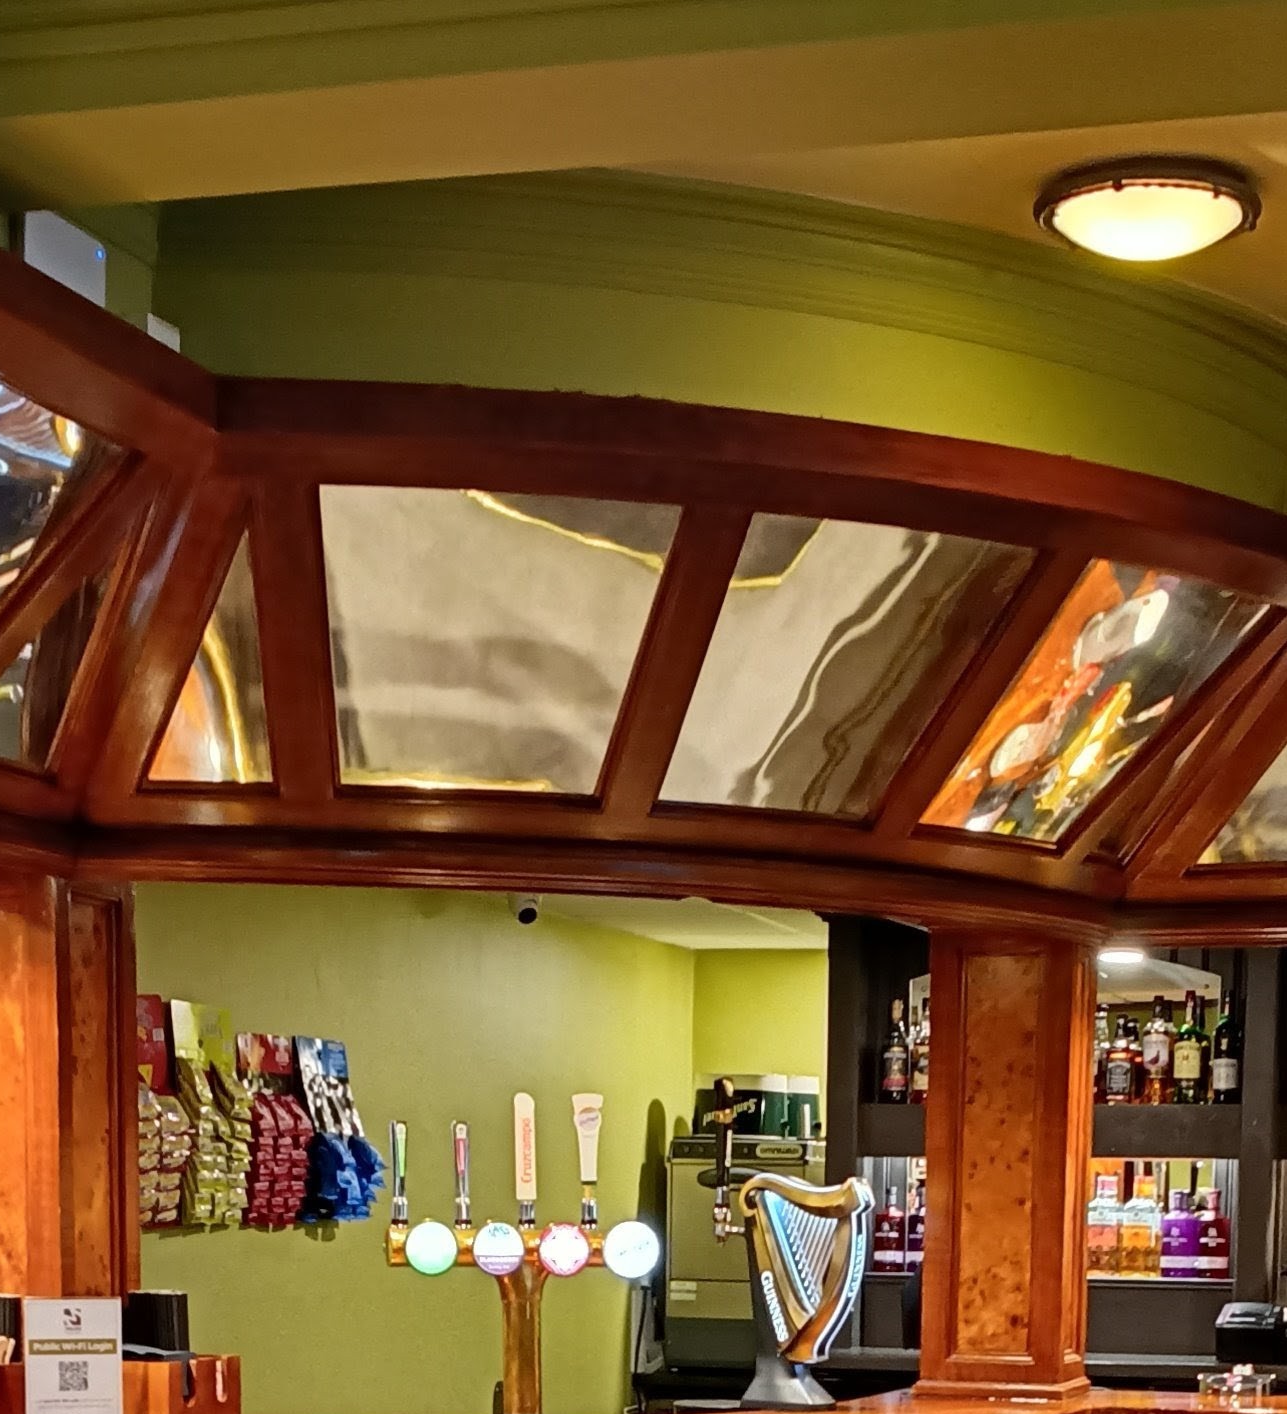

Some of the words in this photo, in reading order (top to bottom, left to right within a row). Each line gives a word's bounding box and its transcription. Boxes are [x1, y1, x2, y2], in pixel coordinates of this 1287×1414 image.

[521, 1117, 532, 1184] Cruzcampo
[761, 1270, 790, 1343] GUINNESS
[33, 1341, 61, 1352] Public
[62, 1341, 86, 1351] Wi-Fi
[87, 1341, 113, 1353] Login
